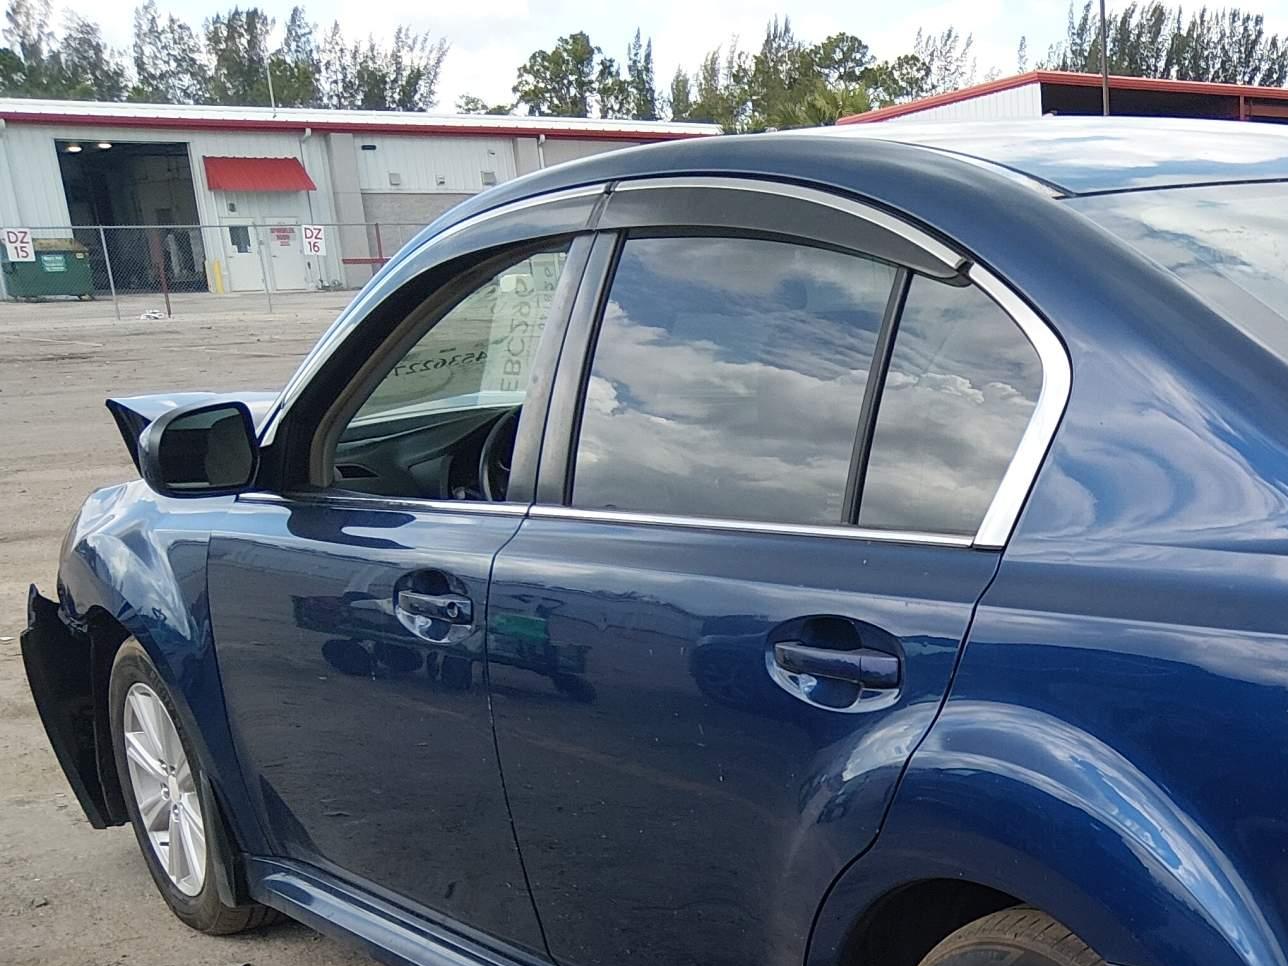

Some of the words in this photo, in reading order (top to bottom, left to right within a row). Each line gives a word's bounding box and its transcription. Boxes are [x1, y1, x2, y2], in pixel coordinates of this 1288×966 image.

[7, 231, 30, 243] DZ
[304, 227, 323, 240] DZ
[14, 246, 29, 258] 15
[308, 241, 320, 253] 16
